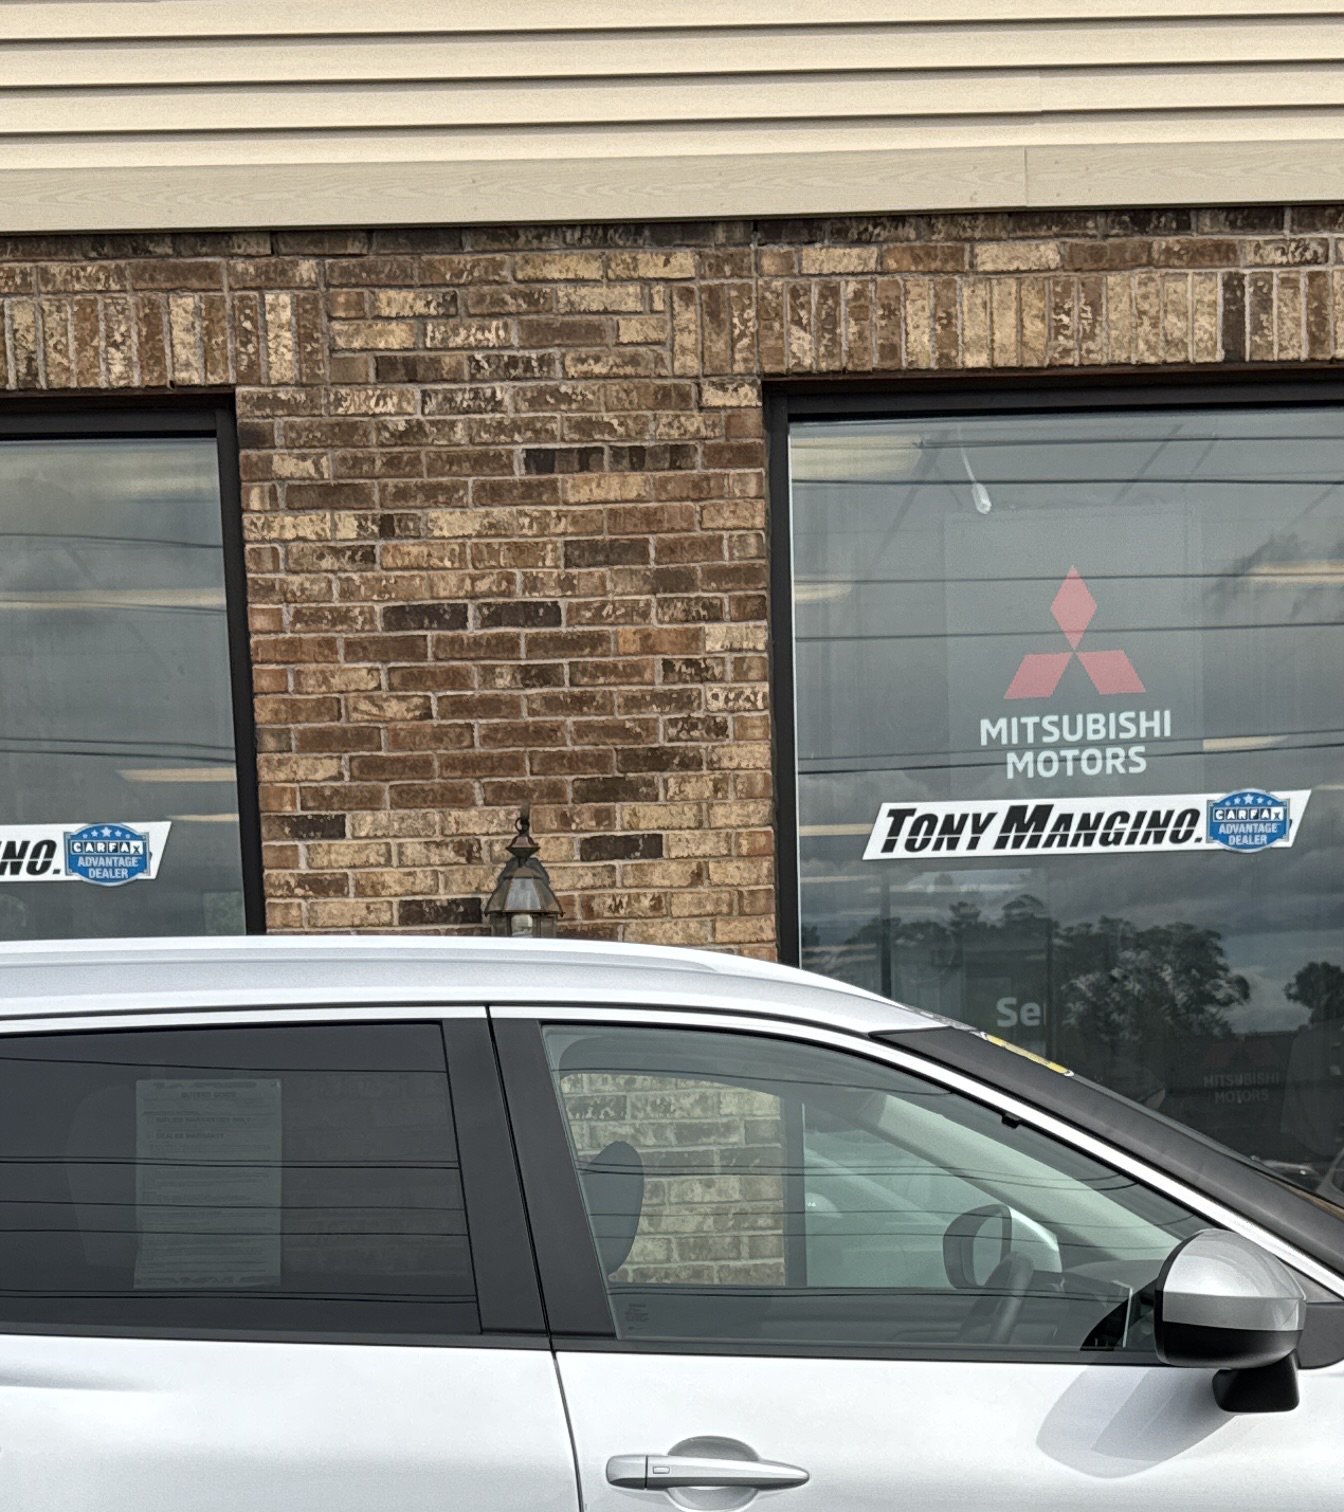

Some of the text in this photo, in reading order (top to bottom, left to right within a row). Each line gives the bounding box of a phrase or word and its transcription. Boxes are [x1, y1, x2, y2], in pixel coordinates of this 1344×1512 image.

[980, 709, 1171, 746] MITSUBISHI
[1007, 746, 1147, 779] MOTORS
[1214, 807, 1284, 821] CARFAX
[880, 807, 998, 854] TONY
[1218, 822, 1278, 834] ADVANTAGE
[71, 841, 144, 854] CARFAX
[1228, 834, 1268, 846] DEALER
[77, 856, 139, 867] ADVANTAGE
[88, 867, 129, 879] DEALER
[996, 996, 1046, 1027] Se
[1203, 1072, 1280, 1088] MITSUBISHI
[1215, 1088, 1269, 1104] MOTORS
